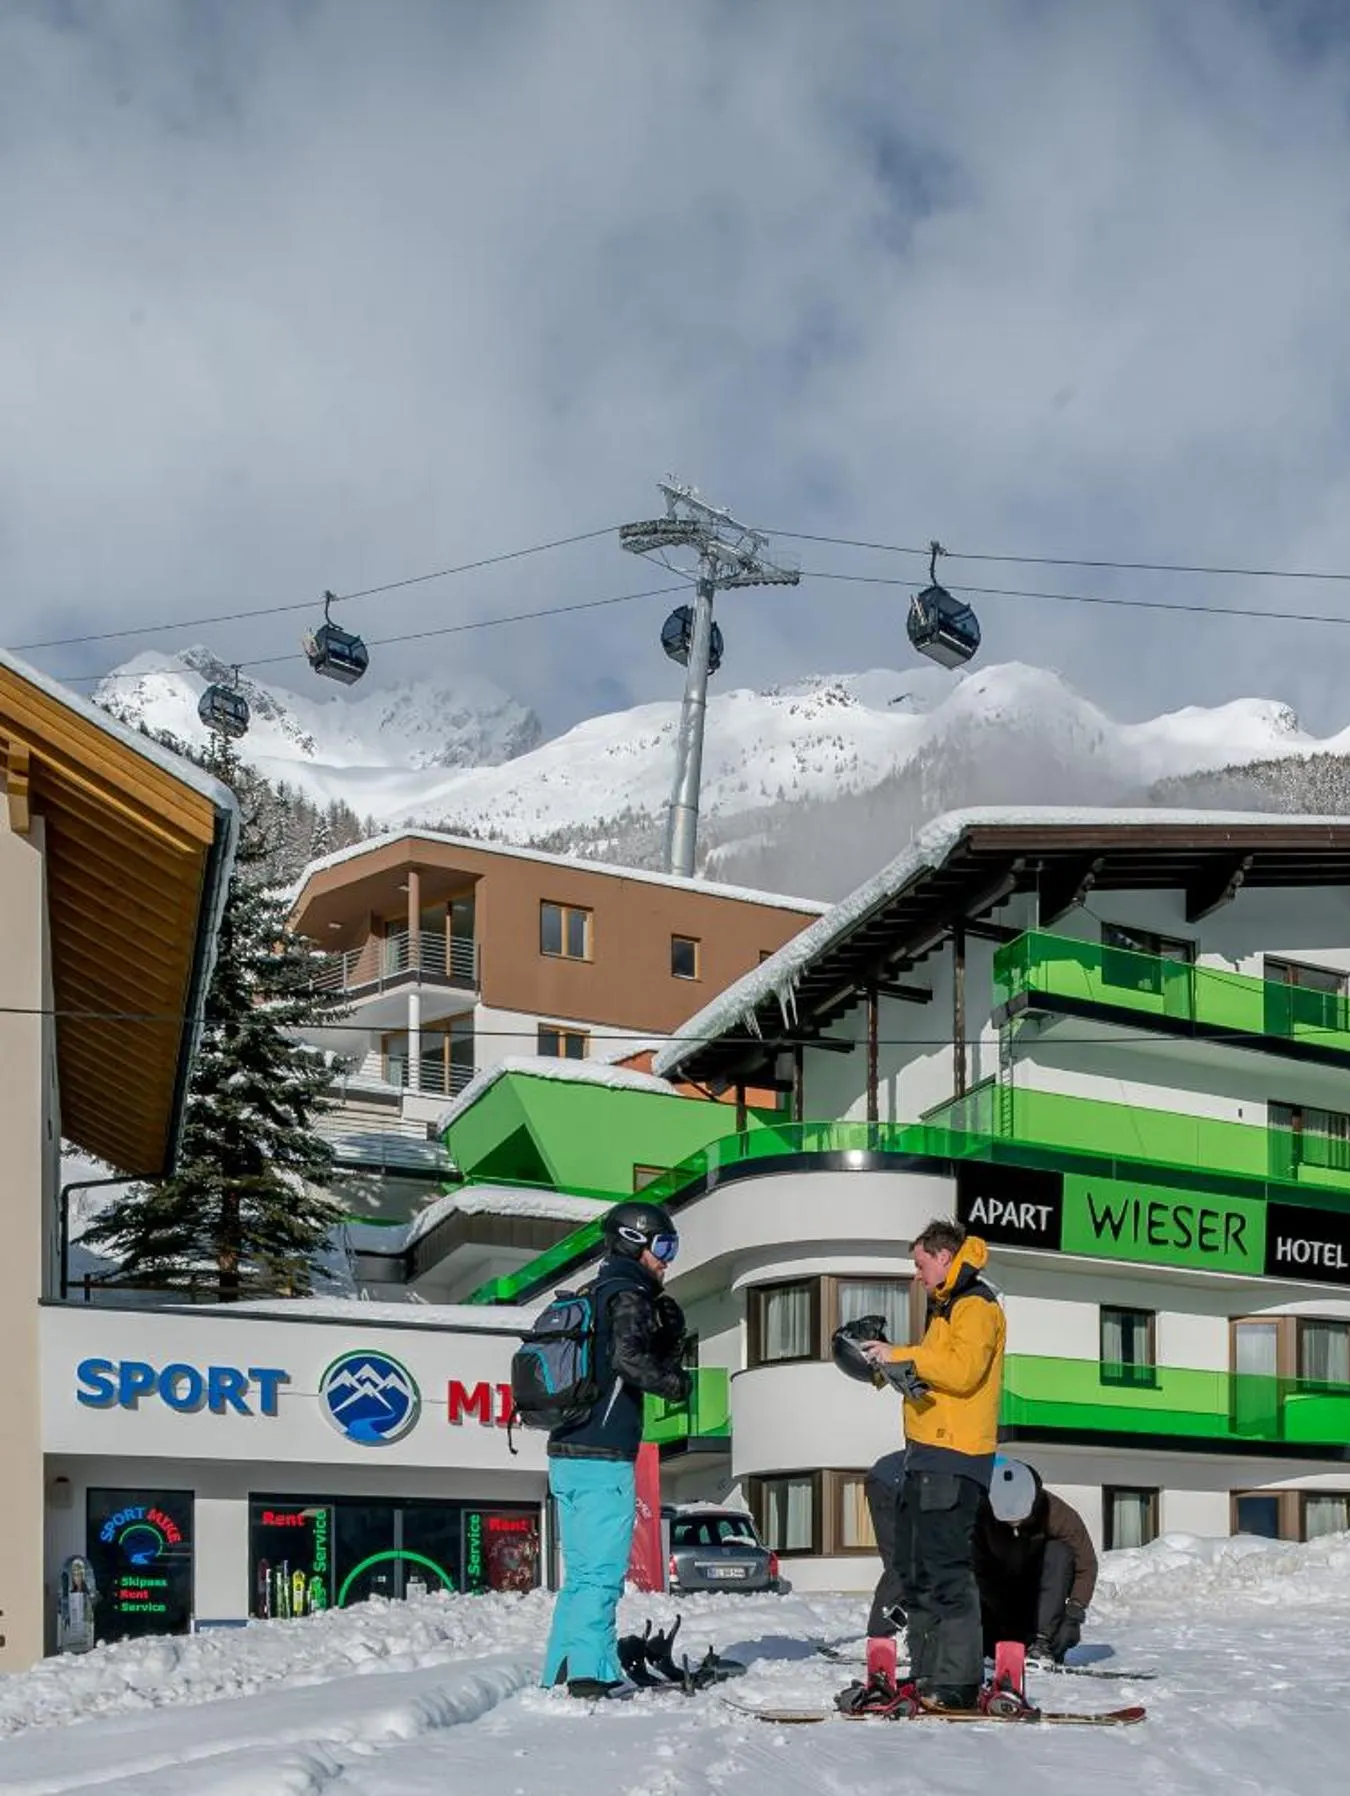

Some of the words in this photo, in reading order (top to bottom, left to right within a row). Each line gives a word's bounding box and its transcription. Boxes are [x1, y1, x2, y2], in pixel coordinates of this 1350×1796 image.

[968, 1196, 1054, 1232] APART
[1087, 1192, 1249, 1256] WIESER
[1277, 1236, 1349, 1269] HOTEL
[76, 1358, 291, 1417] SPORT
[448, 1380, 519, 1428] MI
[100, 1507, 146, 1542] SPORT
[146, 1507, 183, 1544] MIKE
[262, 1511, 305, 1527] Rent
[313, 1509, 327, 1572] Service
[467, 1513, 481, 1577] Service
[120, 1589, 149, 1600] Rent
[121, 1576, 168, 1589] Skipass
[121, 1601, 167, 1613] Service
